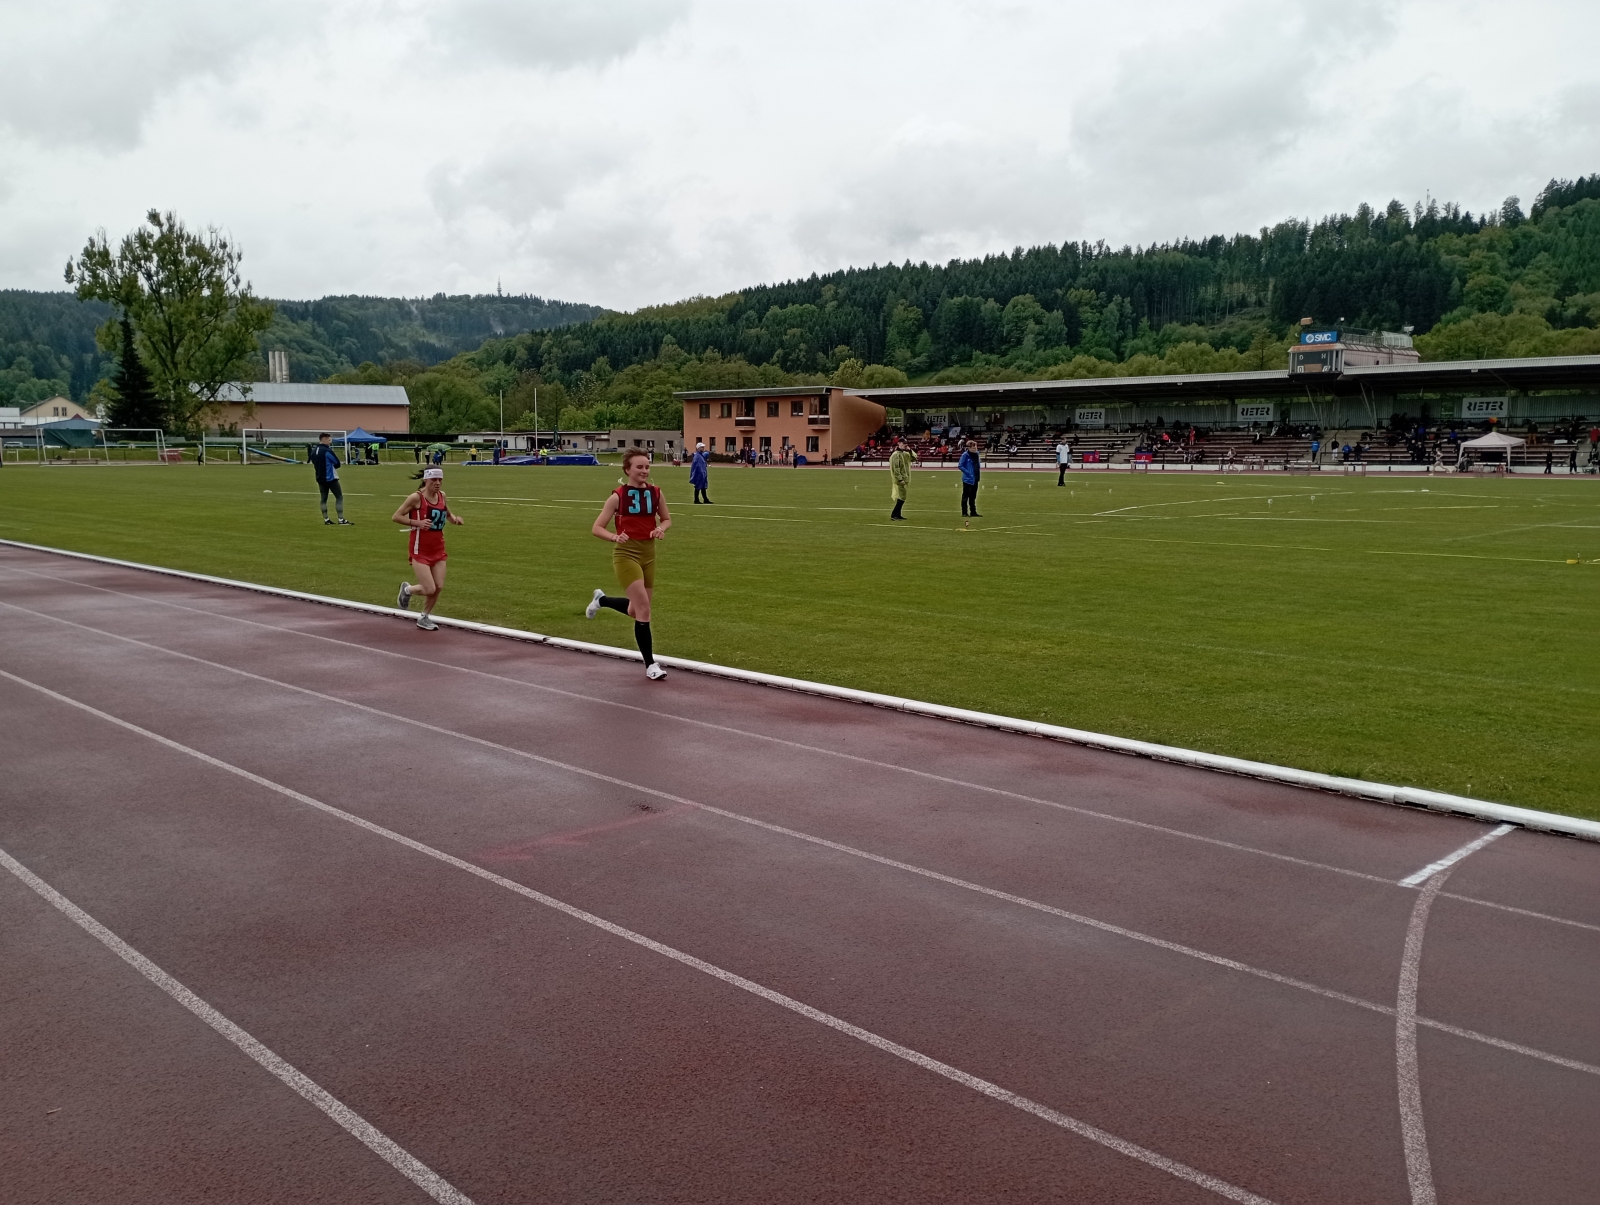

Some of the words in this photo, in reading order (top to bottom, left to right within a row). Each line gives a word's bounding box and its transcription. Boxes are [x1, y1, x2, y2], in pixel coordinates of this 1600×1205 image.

[1314, 333, 1332, 342] SMC
[1467, 400, 1504, 411] RIETER
[1078, 411, 1102, 420] RIETER
[1241, 406, 1270, 416] RIETER
[926, 415, 946, 423] RIETER
[628, 489, 652, 514] 31
